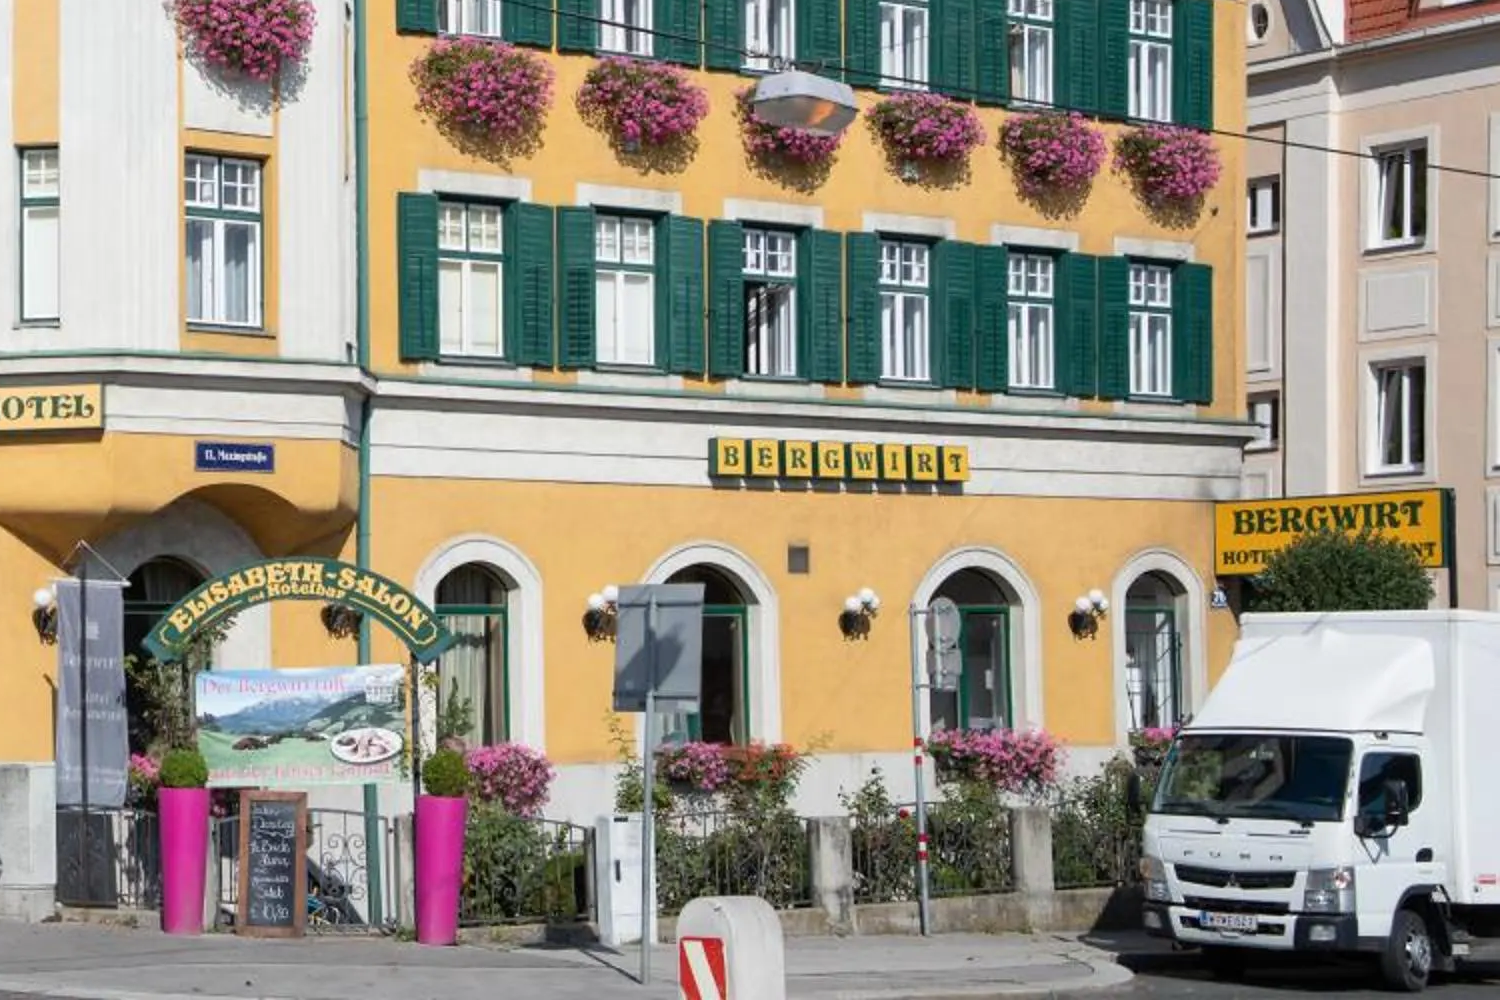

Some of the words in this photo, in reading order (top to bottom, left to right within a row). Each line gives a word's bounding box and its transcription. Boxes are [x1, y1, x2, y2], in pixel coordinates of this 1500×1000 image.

[723, 445, 963, 473] BERGWIRT
[1233, 500, 1424, 535] BERGWIRT
[267, 579, 346, 599] Hotelbar
